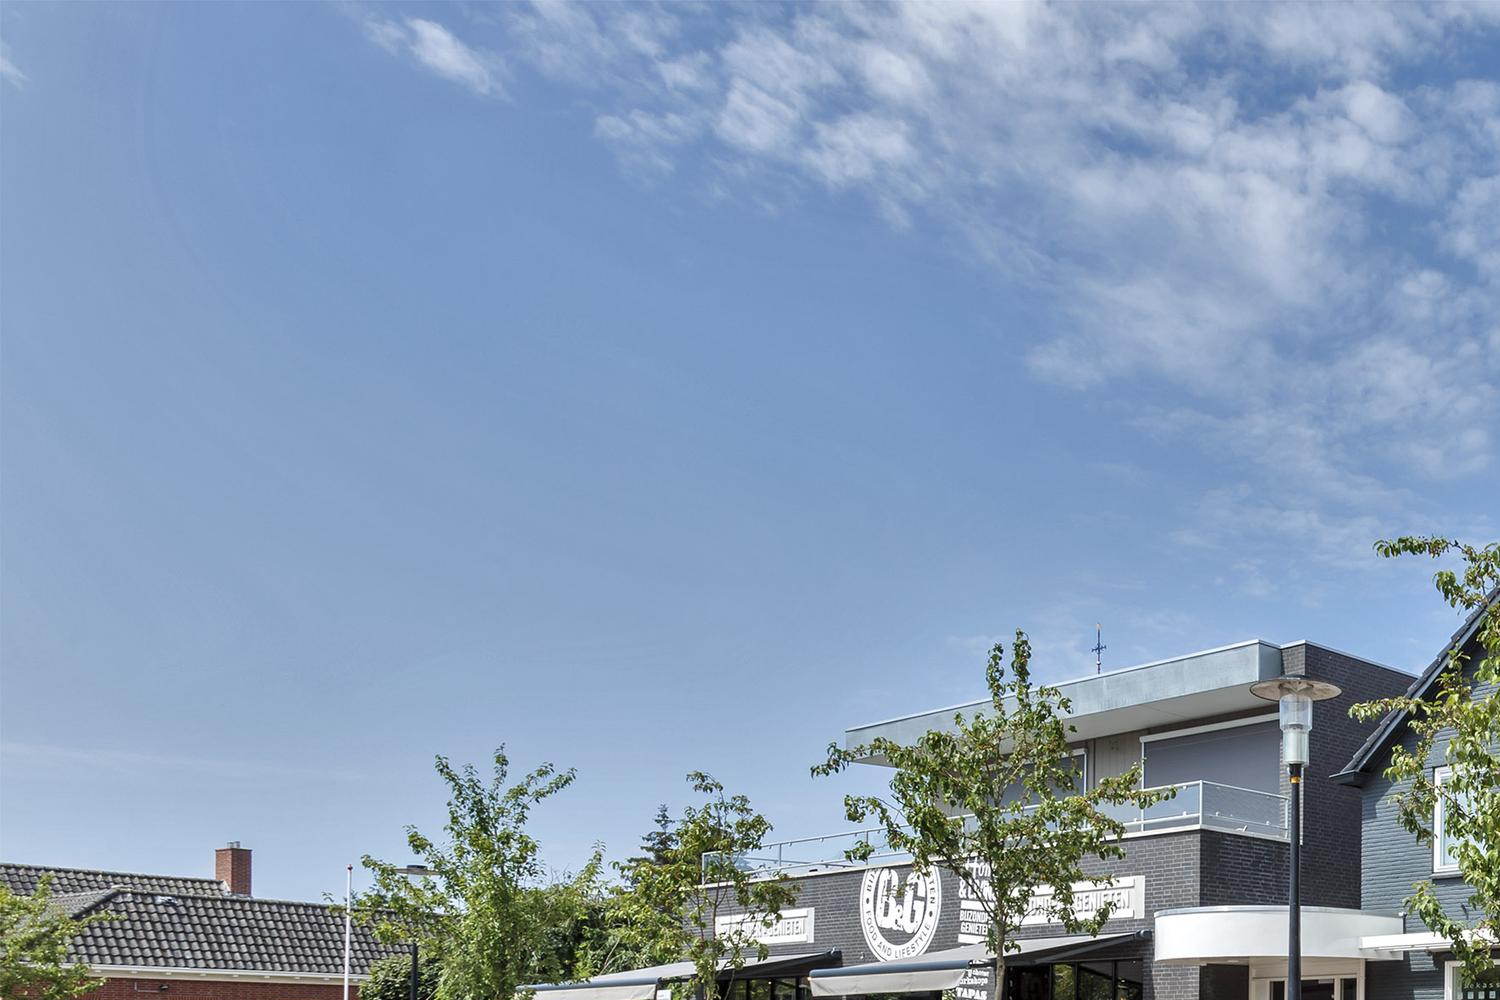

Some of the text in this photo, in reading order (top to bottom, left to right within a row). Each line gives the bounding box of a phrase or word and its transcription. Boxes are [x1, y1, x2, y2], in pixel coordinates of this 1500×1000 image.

[876, 868, 926, 934] B&G
[866, 910, 931, 959] FOOD AND LIFESTYLE
[961, 921, 989, 936] GENIETE
[956, 987, 988, 1000] TAPAS
